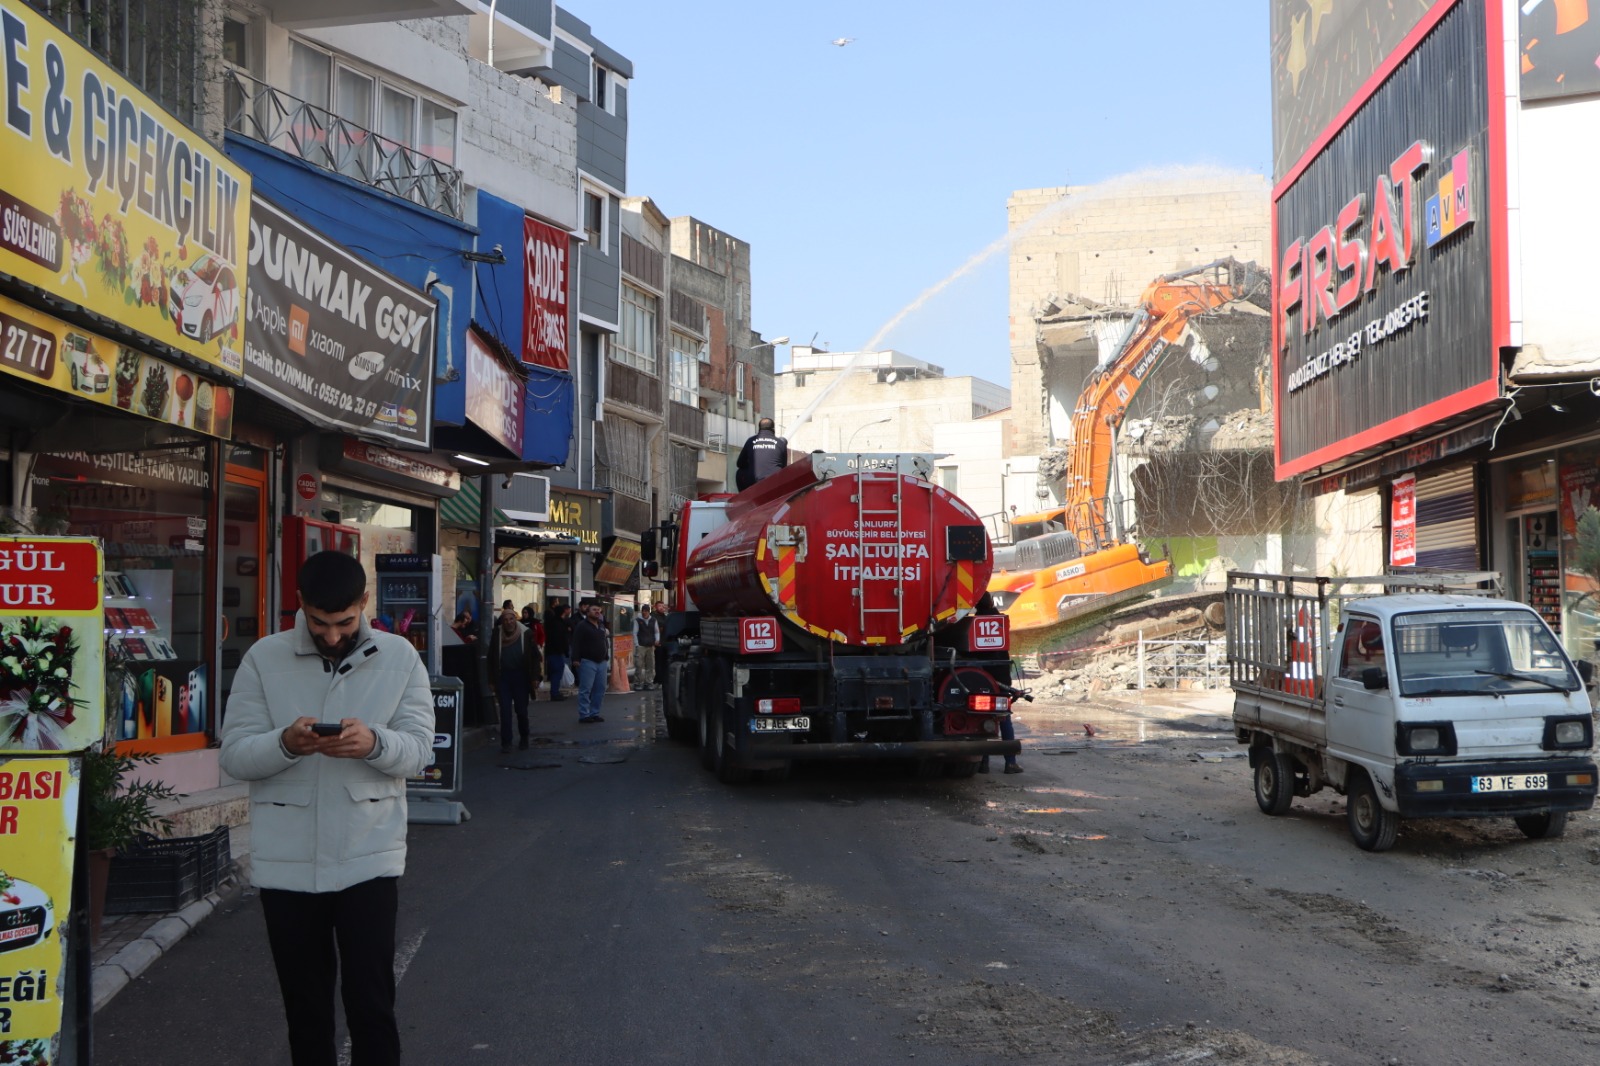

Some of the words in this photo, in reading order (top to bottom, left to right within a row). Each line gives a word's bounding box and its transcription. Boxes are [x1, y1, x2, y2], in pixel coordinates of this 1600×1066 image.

[45, 40, 73, 165] &
[83, 70, 241, 266] ÇİÇEKÇİLİK
[3, 204, 57, 265] SÜSLENİR
[1281, 140, 1430, 351] FIRSAT
[526, 236, 565, 304] CADDE
[255, 295, 288, 336] Apple
[375, 295, 428, 354] GSM
[5, 324, 28, 363] 27
[31, 334, 52, 371] 77
[275, 358, 315, 396] DUNMAK
[319, 382, 340, 406] 0555
[365, 400, 377, 418] 63
[177, 465, 209, 489] YAPILIR
[0, 544, 65, 571] GÜL
[825, 543, 929, 560] ŞANLIURFA
[749, 622, 772, 638] 112
[978, 620, 1000, 636] 112
[437, 694, 455, 708] GSM
[756, 719, 767, 729] 63
[792, 717, 808, 728] 460
[1479, 777, 1493, 791] 63
[1501, 776, 1514, 790] YE
[1525, 775, 1546, 789] 699
